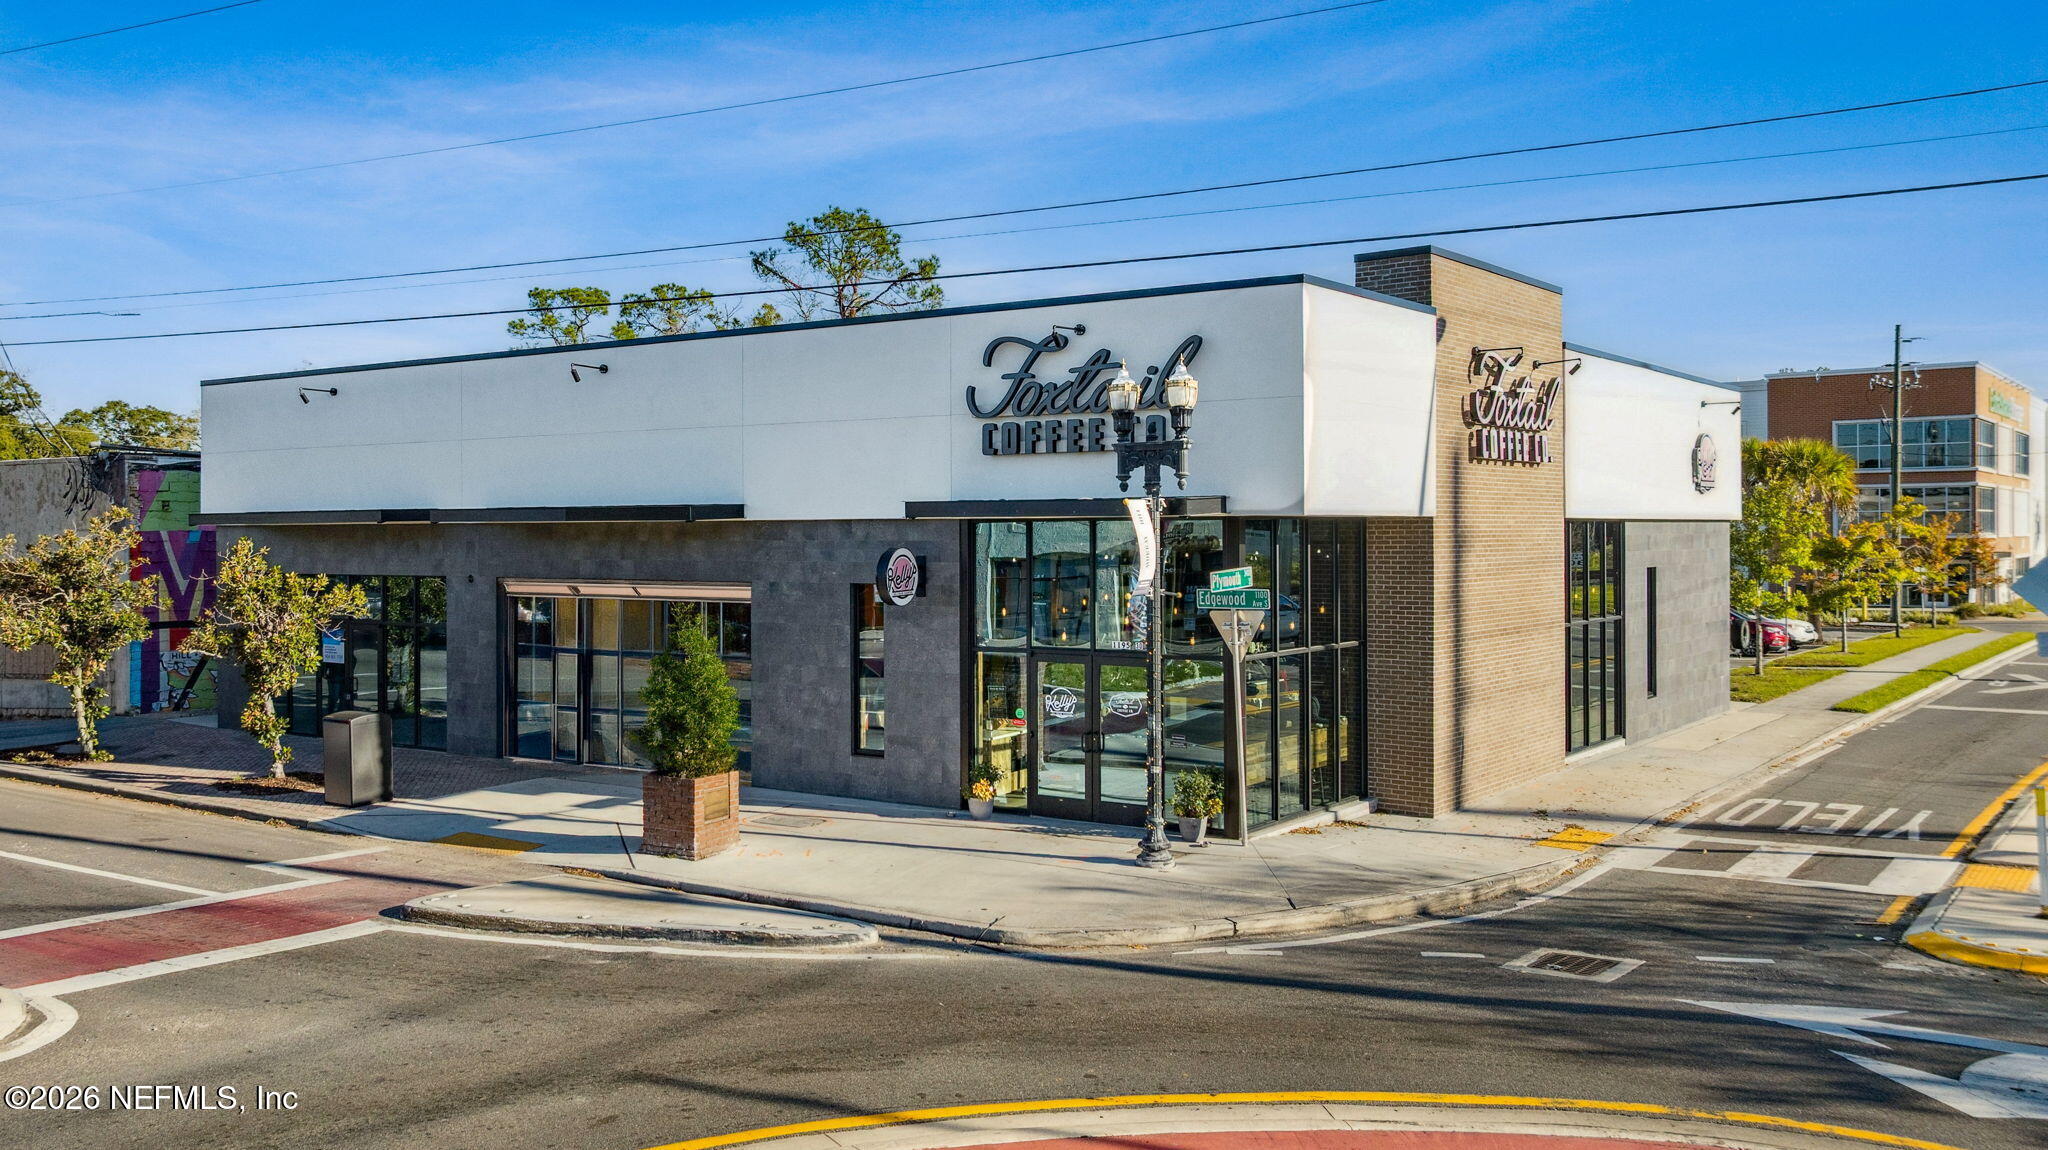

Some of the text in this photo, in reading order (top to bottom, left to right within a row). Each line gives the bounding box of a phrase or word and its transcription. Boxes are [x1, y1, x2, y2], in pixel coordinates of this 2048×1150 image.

[1472, 351, 1560, 431] Foxtail
[982, 417, 1107, 455] COFFEE
[1478, 428, 1530, 462] COFFEE
[1211, 571, 1242, 590] Plymouth
[1199, 591, 1268, 607] Edgewood 1100
[1252, 600, 1263, 608] Ave
[171, 652, 192, 660] HILL
[1715, 798, 1932, 841] YIELD
